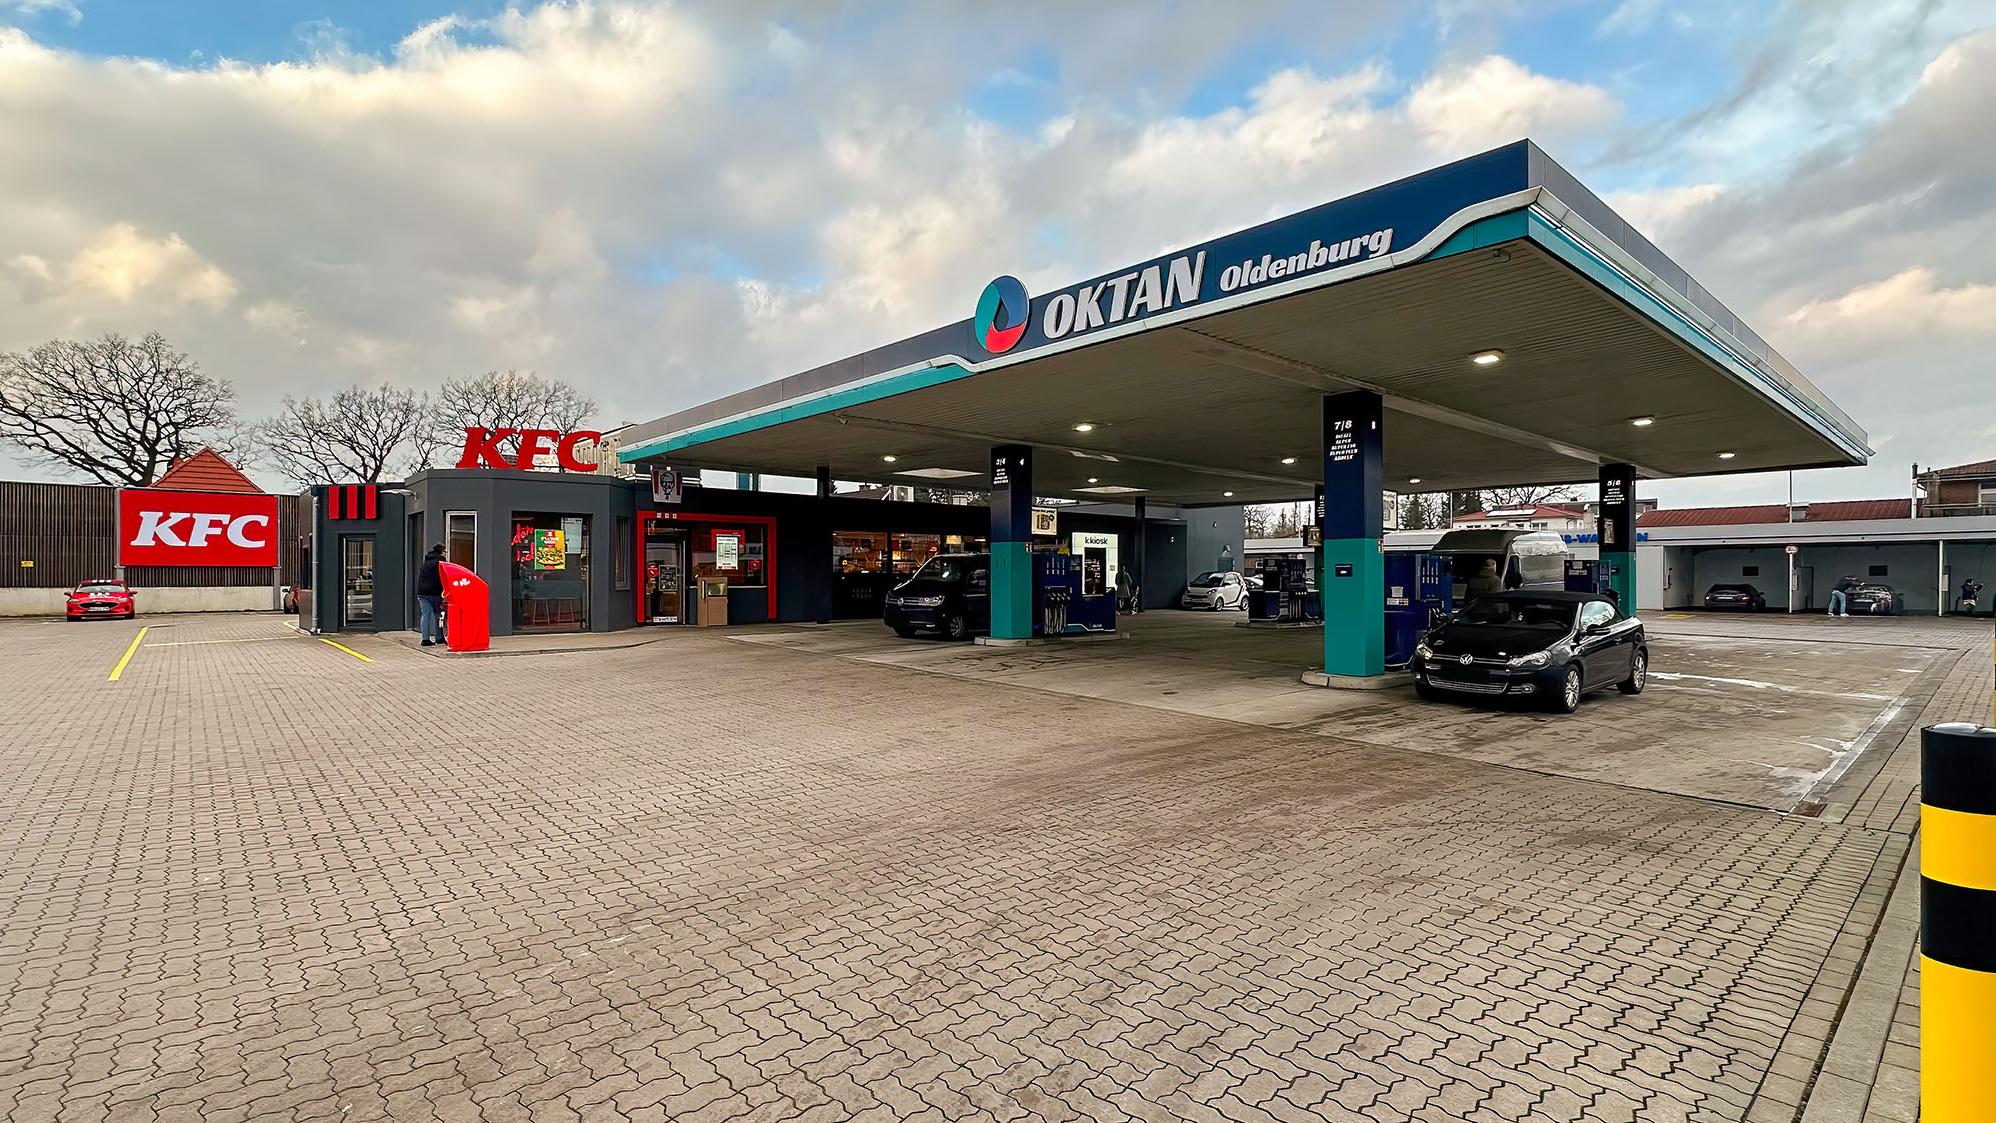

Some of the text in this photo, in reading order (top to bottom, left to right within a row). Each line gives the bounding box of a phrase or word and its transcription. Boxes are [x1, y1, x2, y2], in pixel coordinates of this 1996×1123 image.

[1043, 227, 1394, 339] OKTAN Oldenburg
[455, 427, 601, 472] KFC
[130, 511, 269, 548] KFC
[1090, 536, 1108, 545] kiosk
